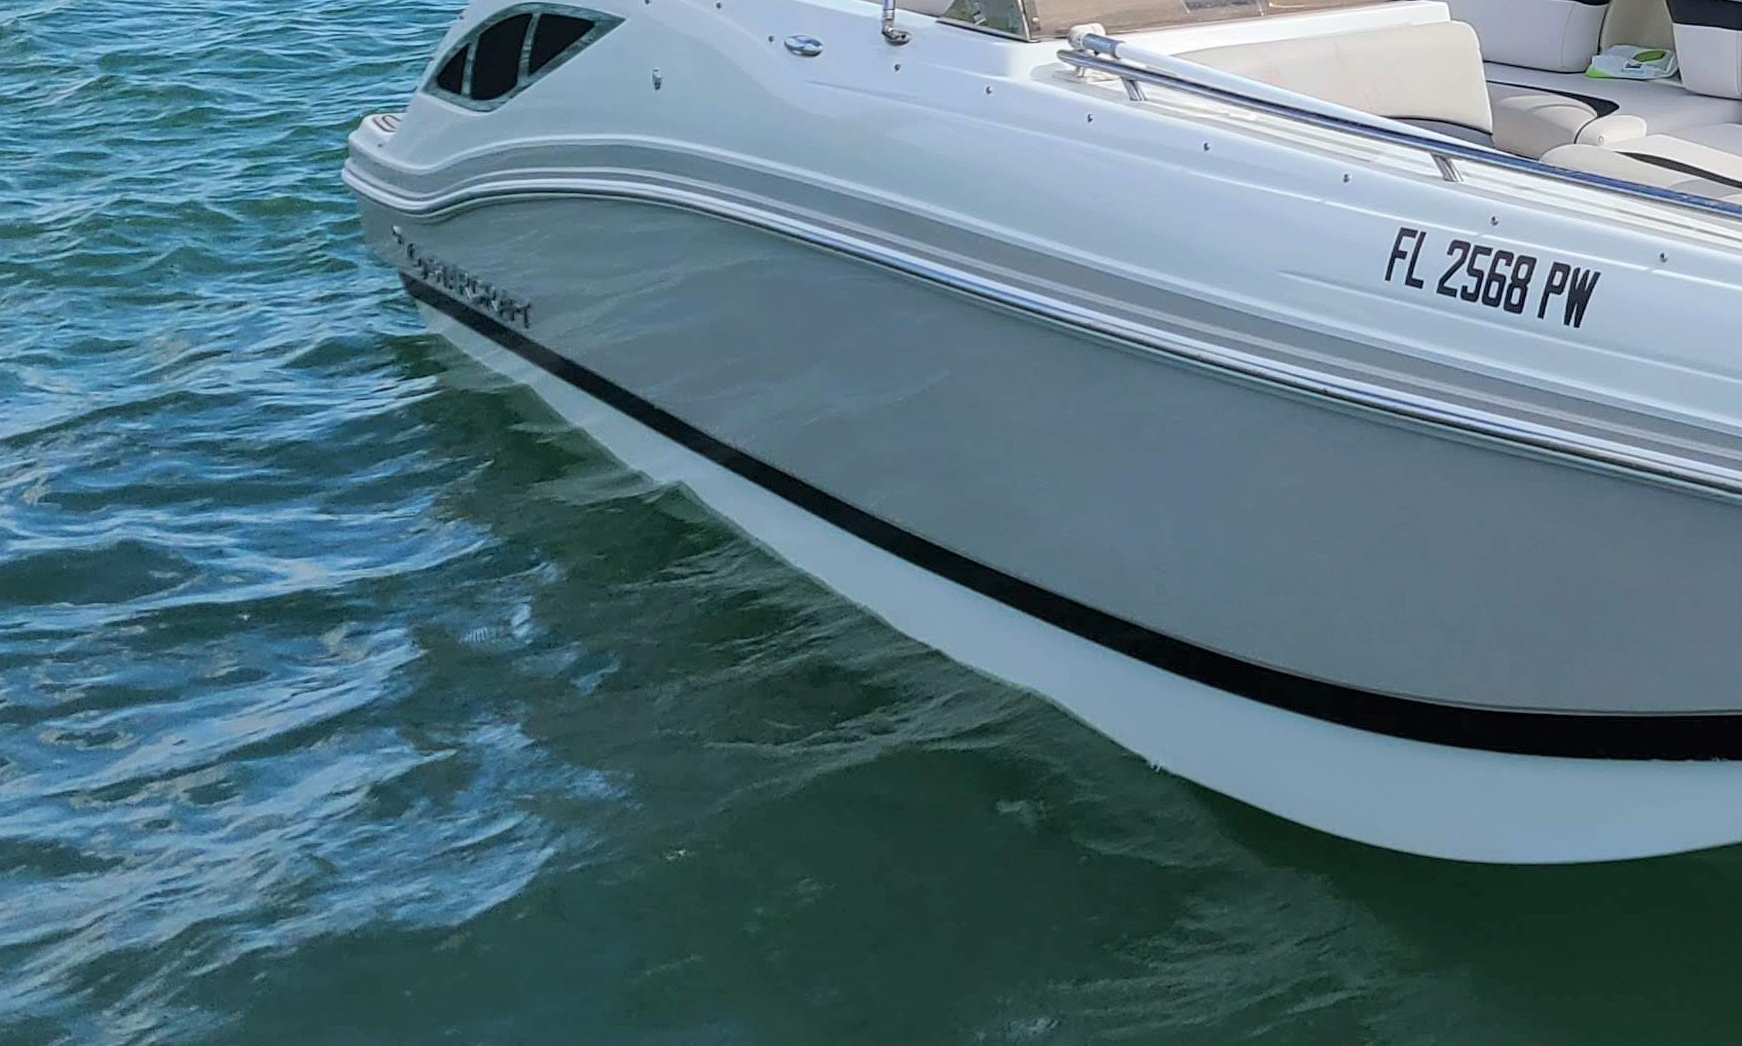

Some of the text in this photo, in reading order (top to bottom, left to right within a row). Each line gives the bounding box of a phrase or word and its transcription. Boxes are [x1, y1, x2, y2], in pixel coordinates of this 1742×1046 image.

[1385, 227, 1601, 328] FL 2568 PW
